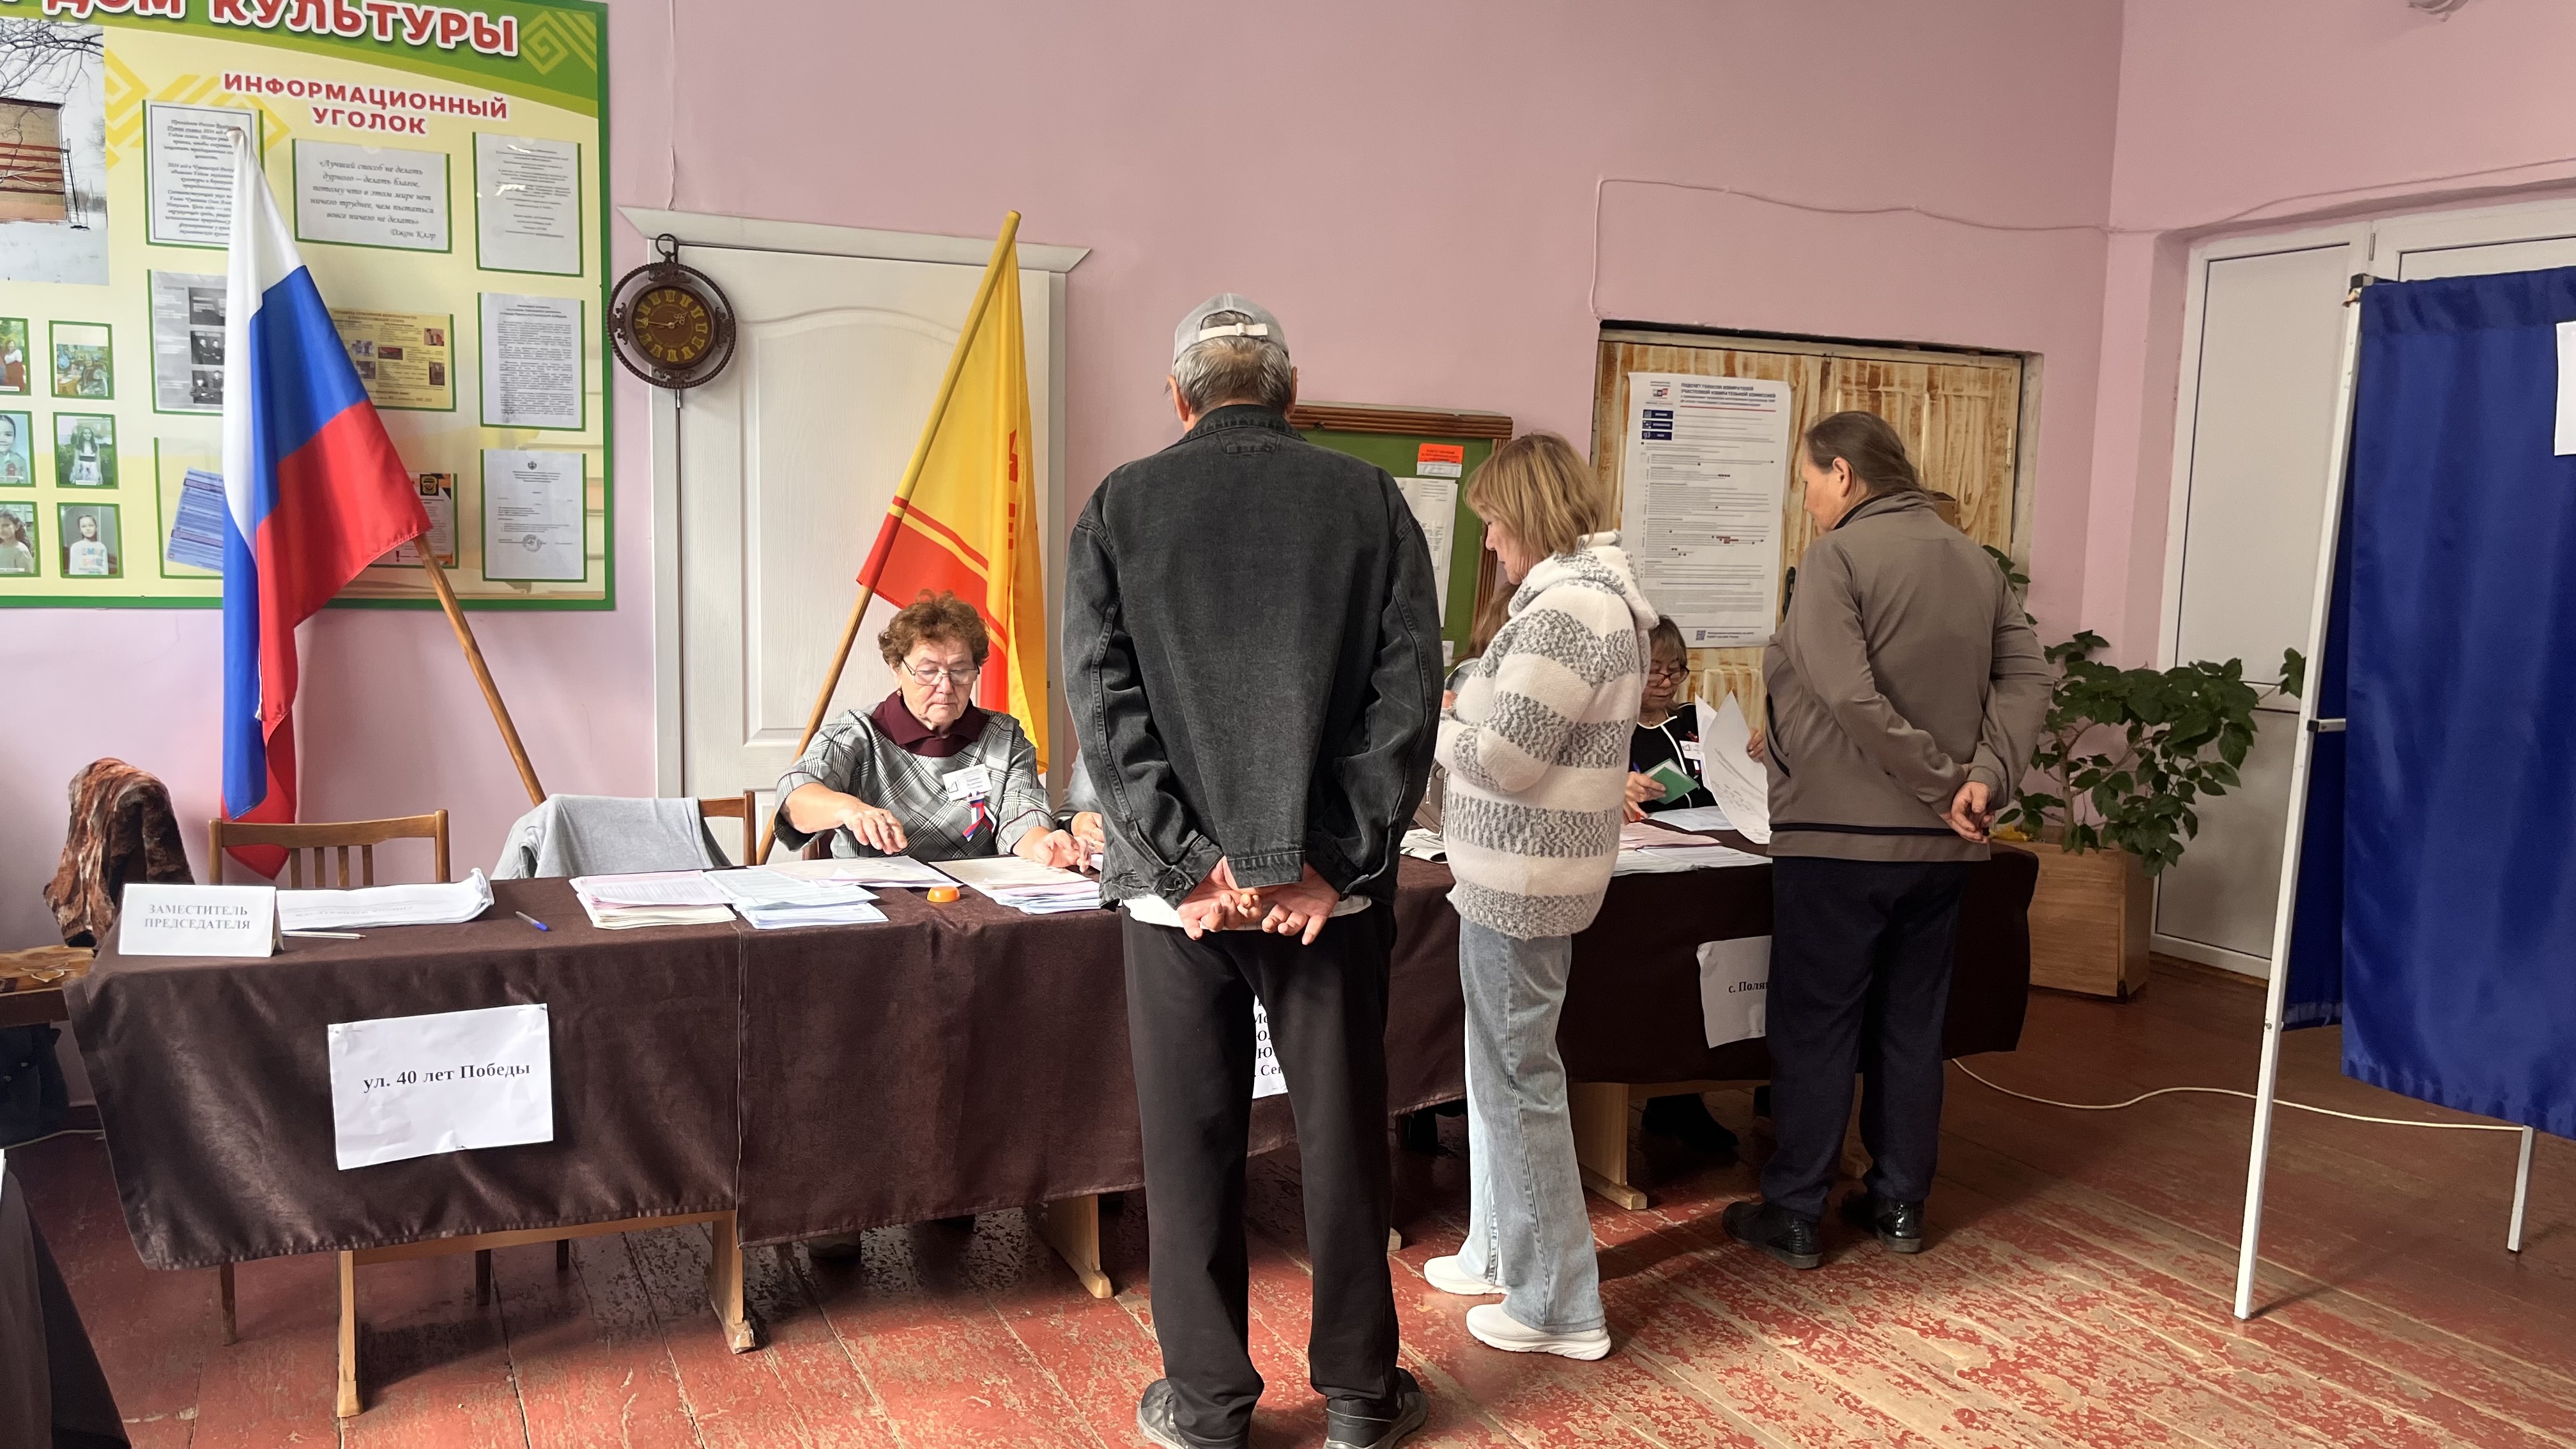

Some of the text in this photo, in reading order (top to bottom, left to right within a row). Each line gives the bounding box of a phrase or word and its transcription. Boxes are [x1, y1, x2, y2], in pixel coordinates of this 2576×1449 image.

[214, 0, 514, 52] КУЛЬТУРЫ
[224, 73, 507, 118] ИНФОРМАЦИОННЫЙ
[312, 107, 426, 134] УГОЛОК
[395, 165, 423, 175] делать
[323, 171, 354, 182] дурного
[364, 174, 392, 184] делать
[312, 185, 344, 195] потому
[394, 193, 414, 201] мире
[394, 205, 434, 214] пытаться
[148, 903, 248, 916] ЗАМЕСТИТЕЛЬ
[144, 917, 250, 930] ПРЕДСЕДАТЕЛЯ
[1728, 985, 1736, 993] с.
[364, 1062, 530, 1094] ул. 40 лет Победы
